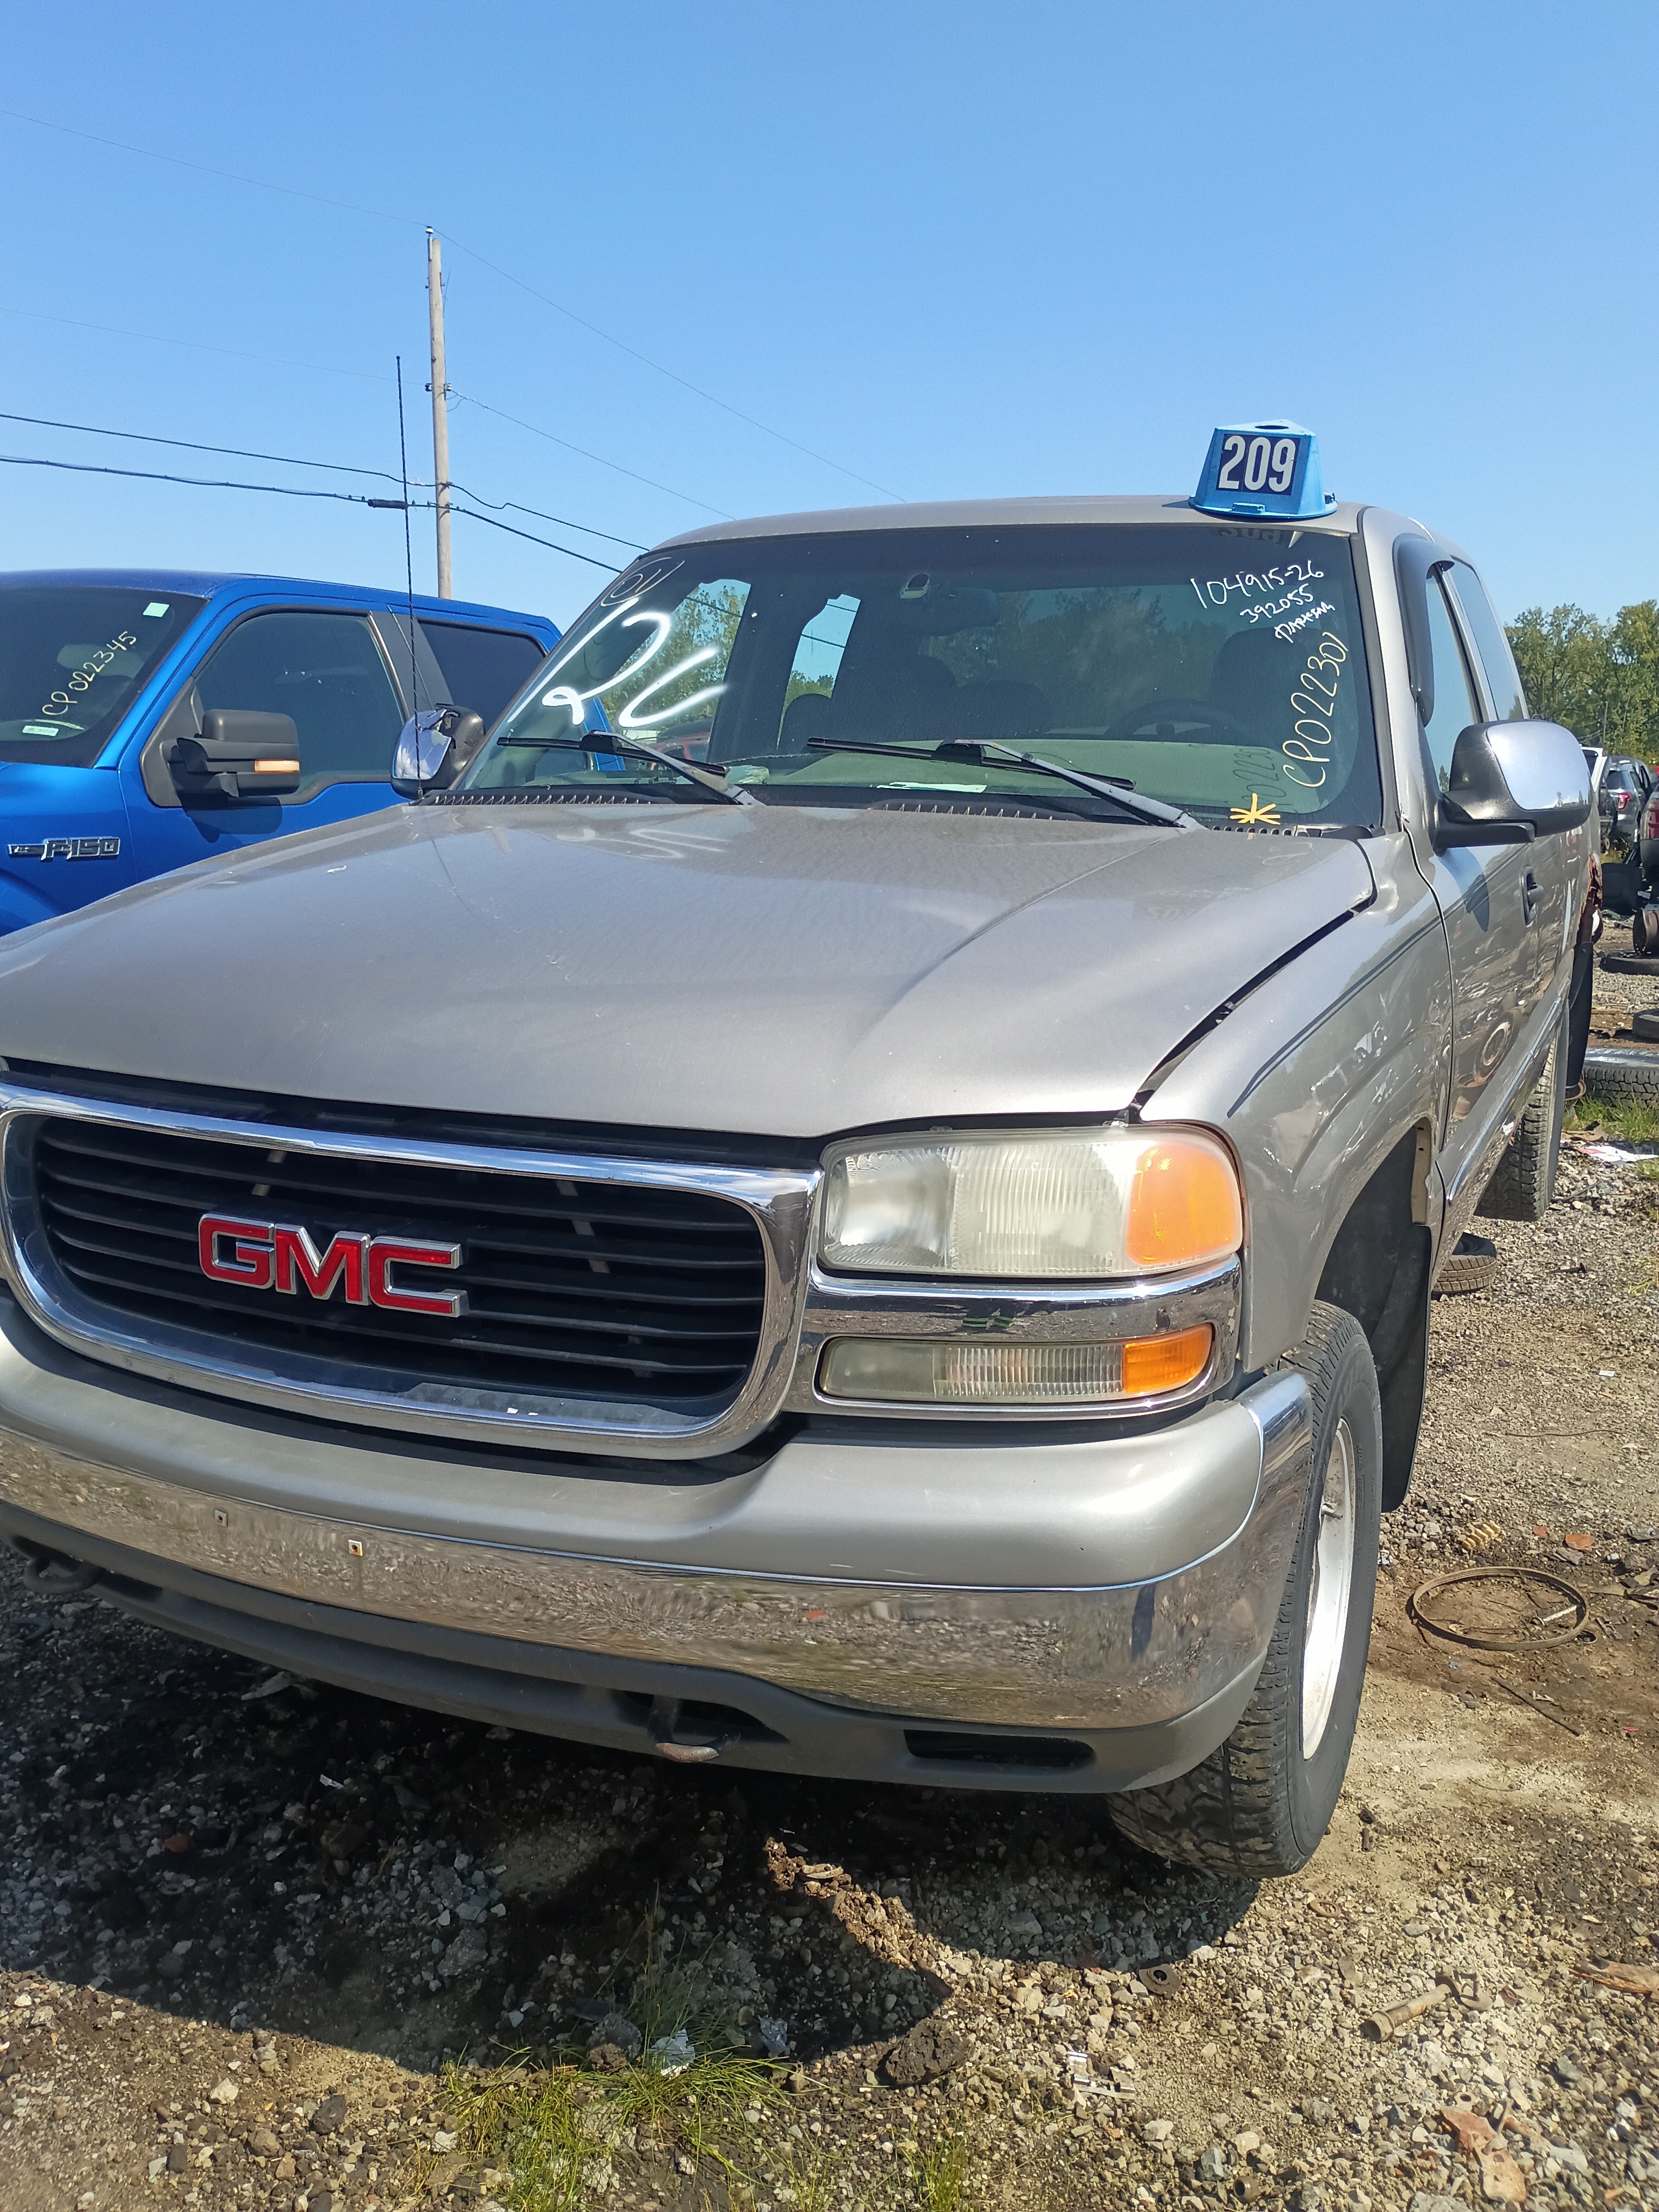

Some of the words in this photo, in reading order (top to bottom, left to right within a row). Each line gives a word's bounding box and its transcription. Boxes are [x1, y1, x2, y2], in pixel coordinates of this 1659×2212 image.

[1218, 435, 1296, 492] 209
[1190, 560, 1324, 609] 104915-26
[1239, 583, 1313, 623] 392055
[42, 691, 78, 716] CP
[68, 630, 137, 691] 022345
[198, 1212, 468, 1318] GMC
